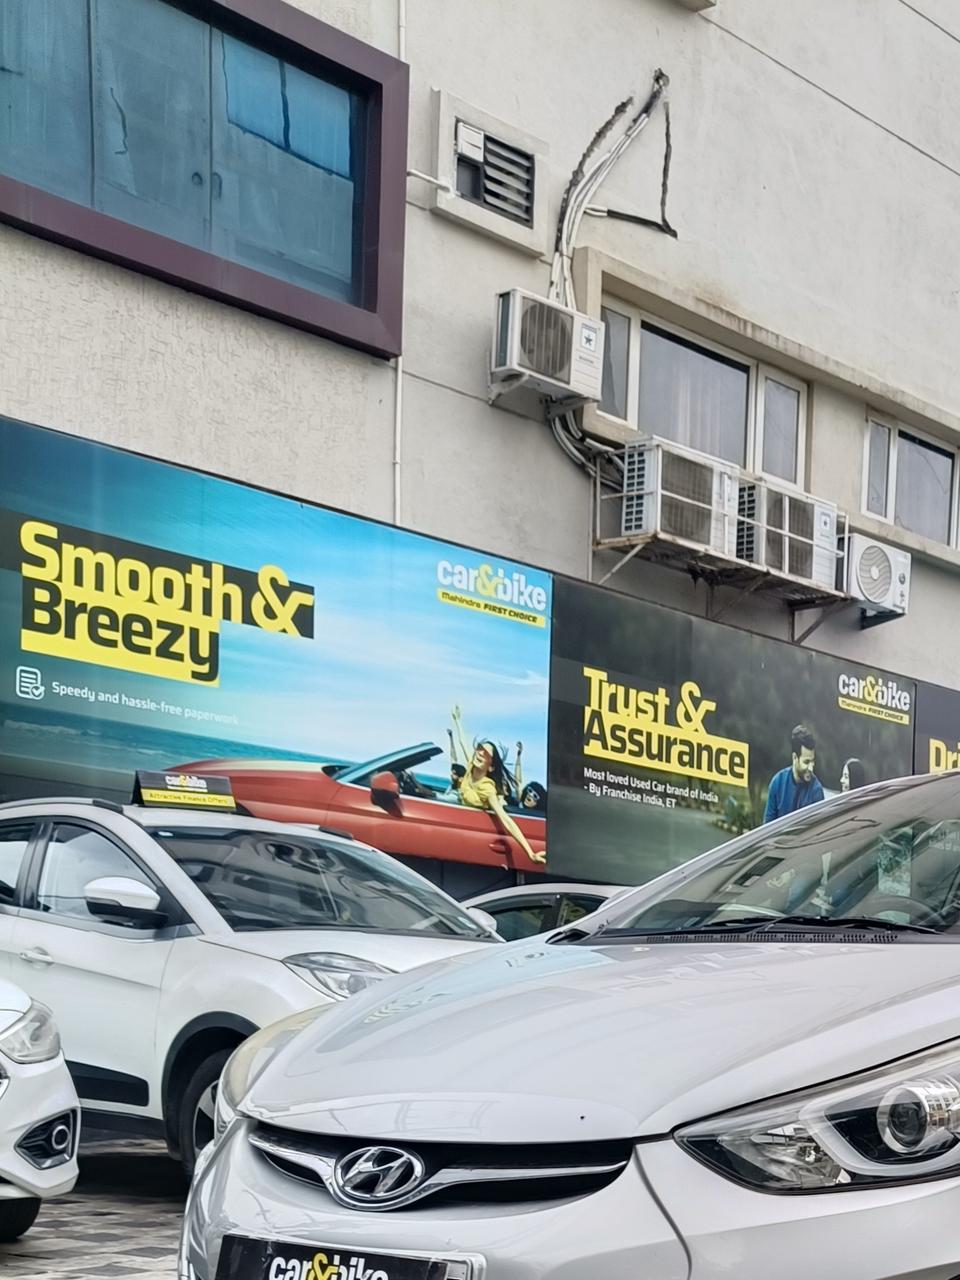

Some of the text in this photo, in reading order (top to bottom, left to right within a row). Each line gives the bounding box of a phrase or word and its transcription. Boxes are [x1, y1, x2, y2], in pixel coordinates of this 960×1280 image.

[19, 520, 316, 638] Smooth &
[437, 560, 547, 611] car&bike
[22, 576, 220, 682] Breezy
[483, 603, 507, 616] FIRST
[508, 610, 538, 623] CHOICE
[51, 681, 239, 726] Speedy and hassle-free paperwork
[583, 666, 717, 735] Trust &
[838, 674, 911, 711] car&bike
[584, 708, 745, 780] Assurance
[583, 767, 719, 803] Most loved Used Car brand of India
[589, 782, 601, 797] By
[602, 785, 641, 802] Franchise
[642, 793, 665, 808] India,
[666, 797, 677, 808] ET
